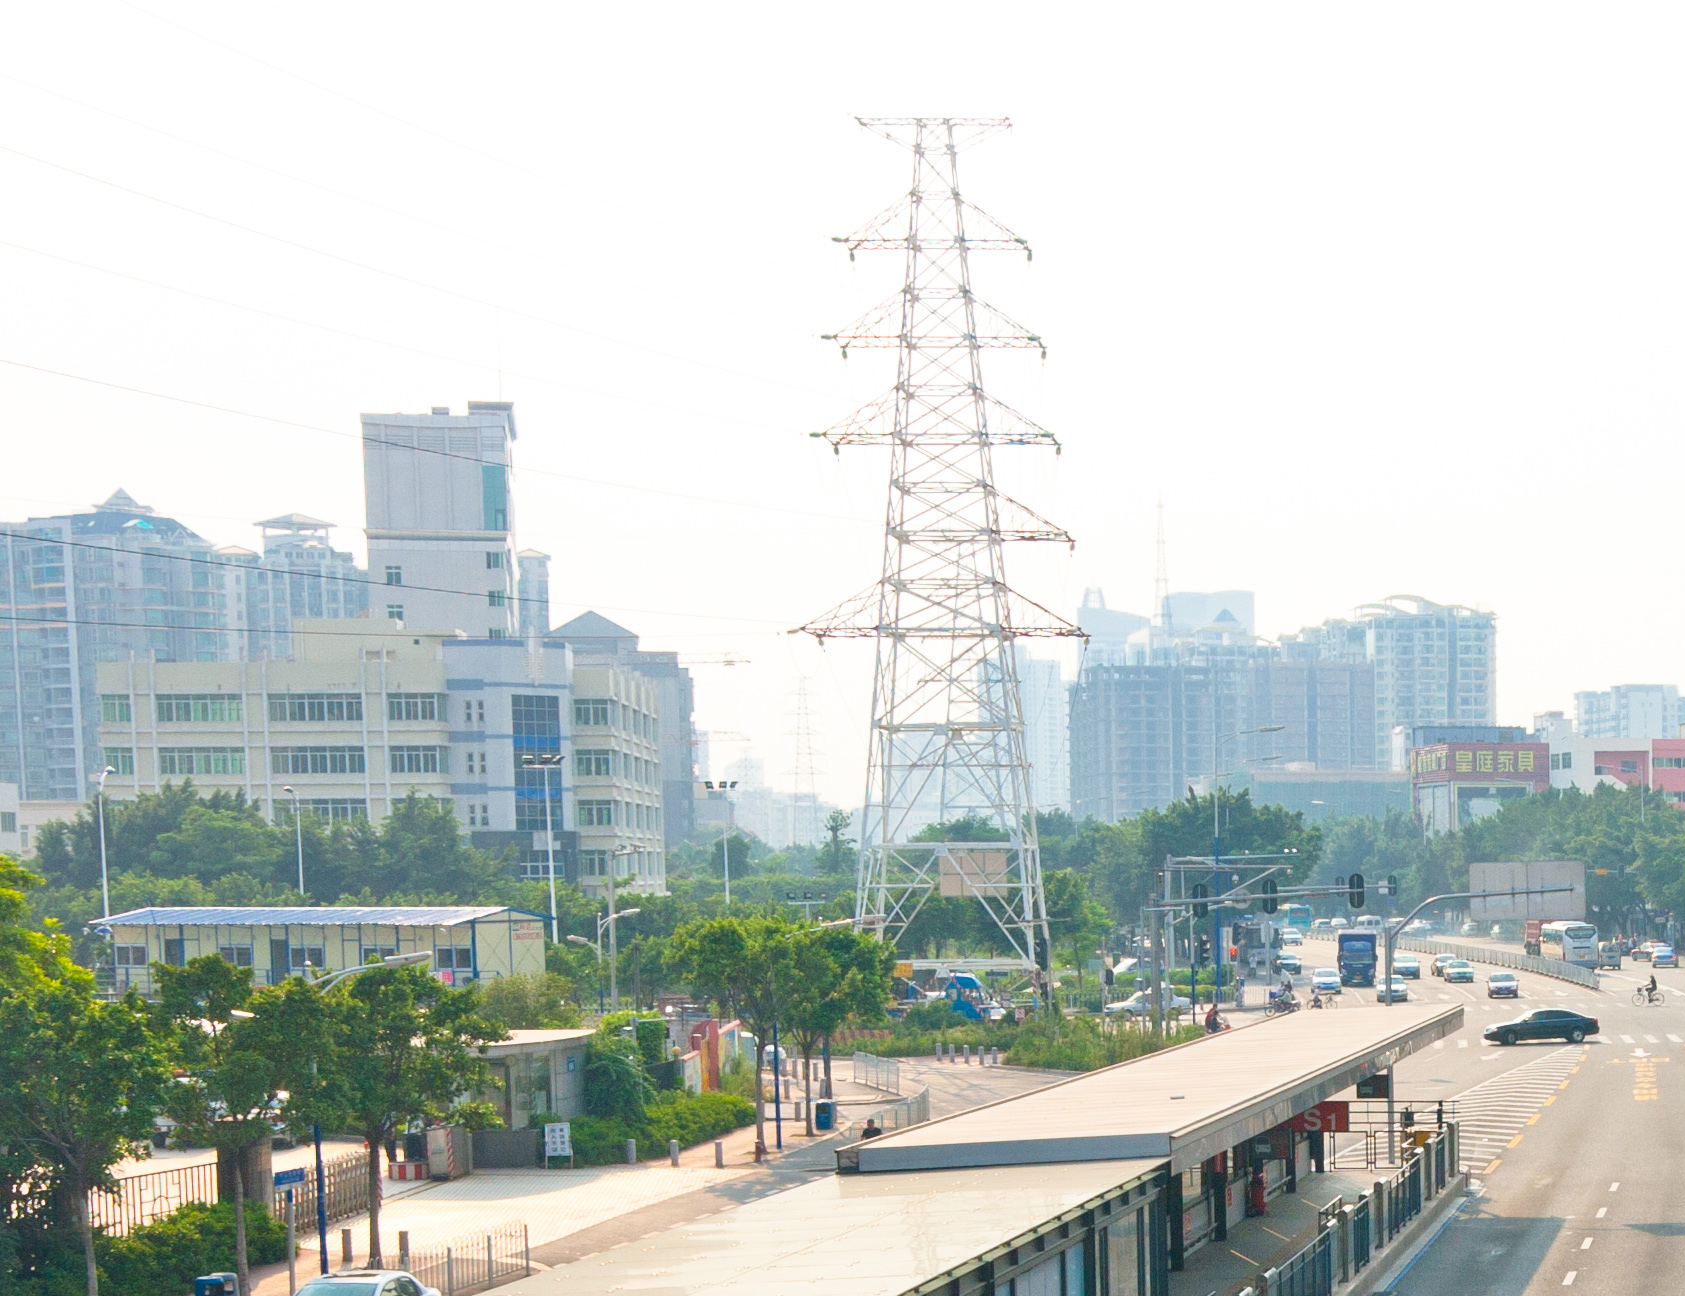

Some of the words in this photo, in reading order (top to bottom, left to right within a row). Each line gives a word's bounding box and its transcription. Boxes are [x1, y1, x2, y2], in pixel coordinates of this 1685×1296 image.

[1455, 750, 1535, 773] 皇庭家具
[1303, 1108, 1336, 1131] S1
